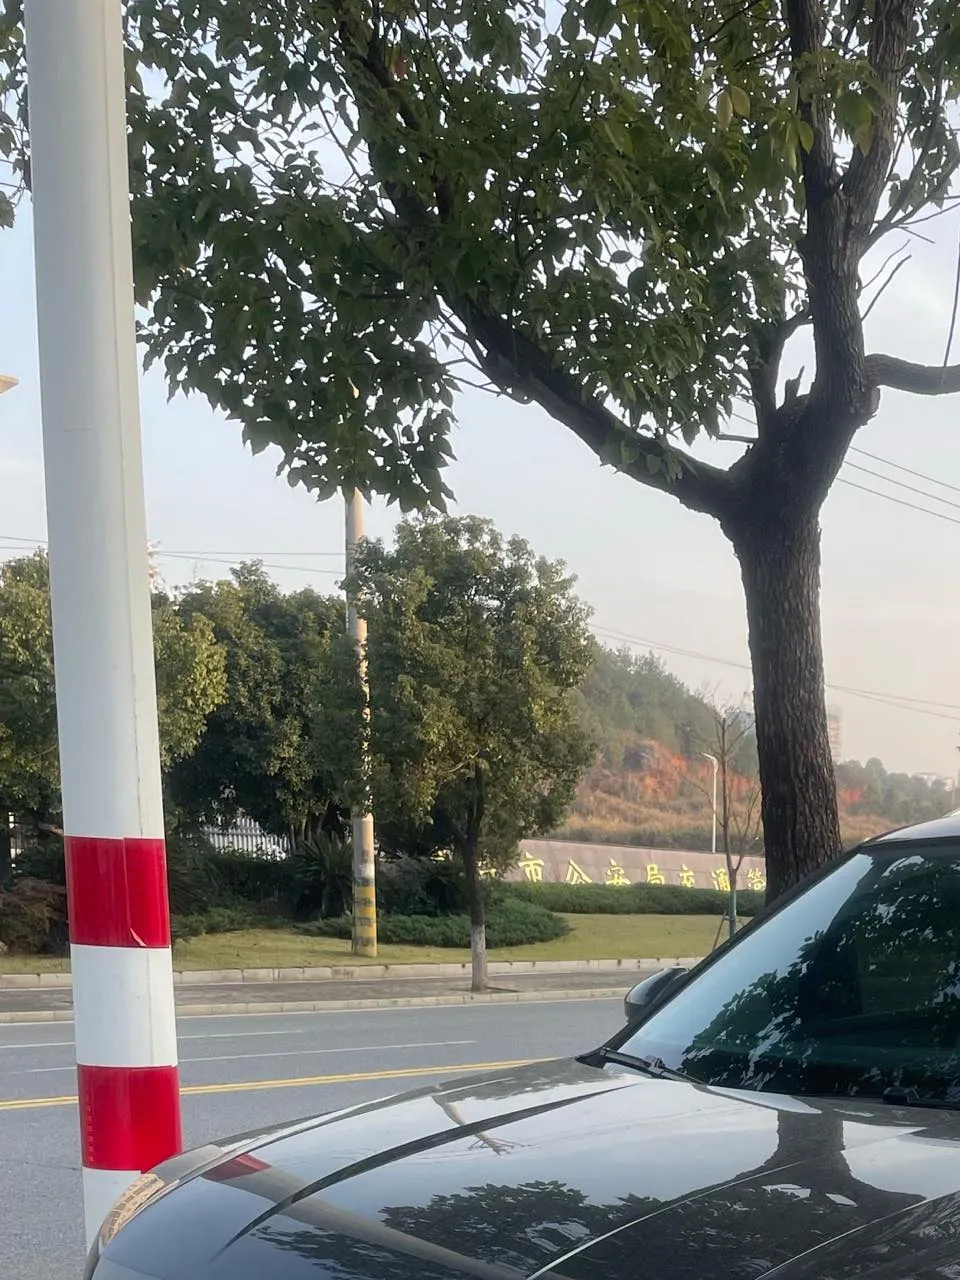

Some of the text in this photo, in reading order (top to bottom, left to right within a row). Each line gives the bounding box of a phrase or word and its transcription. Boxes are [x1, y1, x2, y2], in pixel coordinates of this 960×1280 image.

[478, 852, 766, 892] 市公安局交通管
